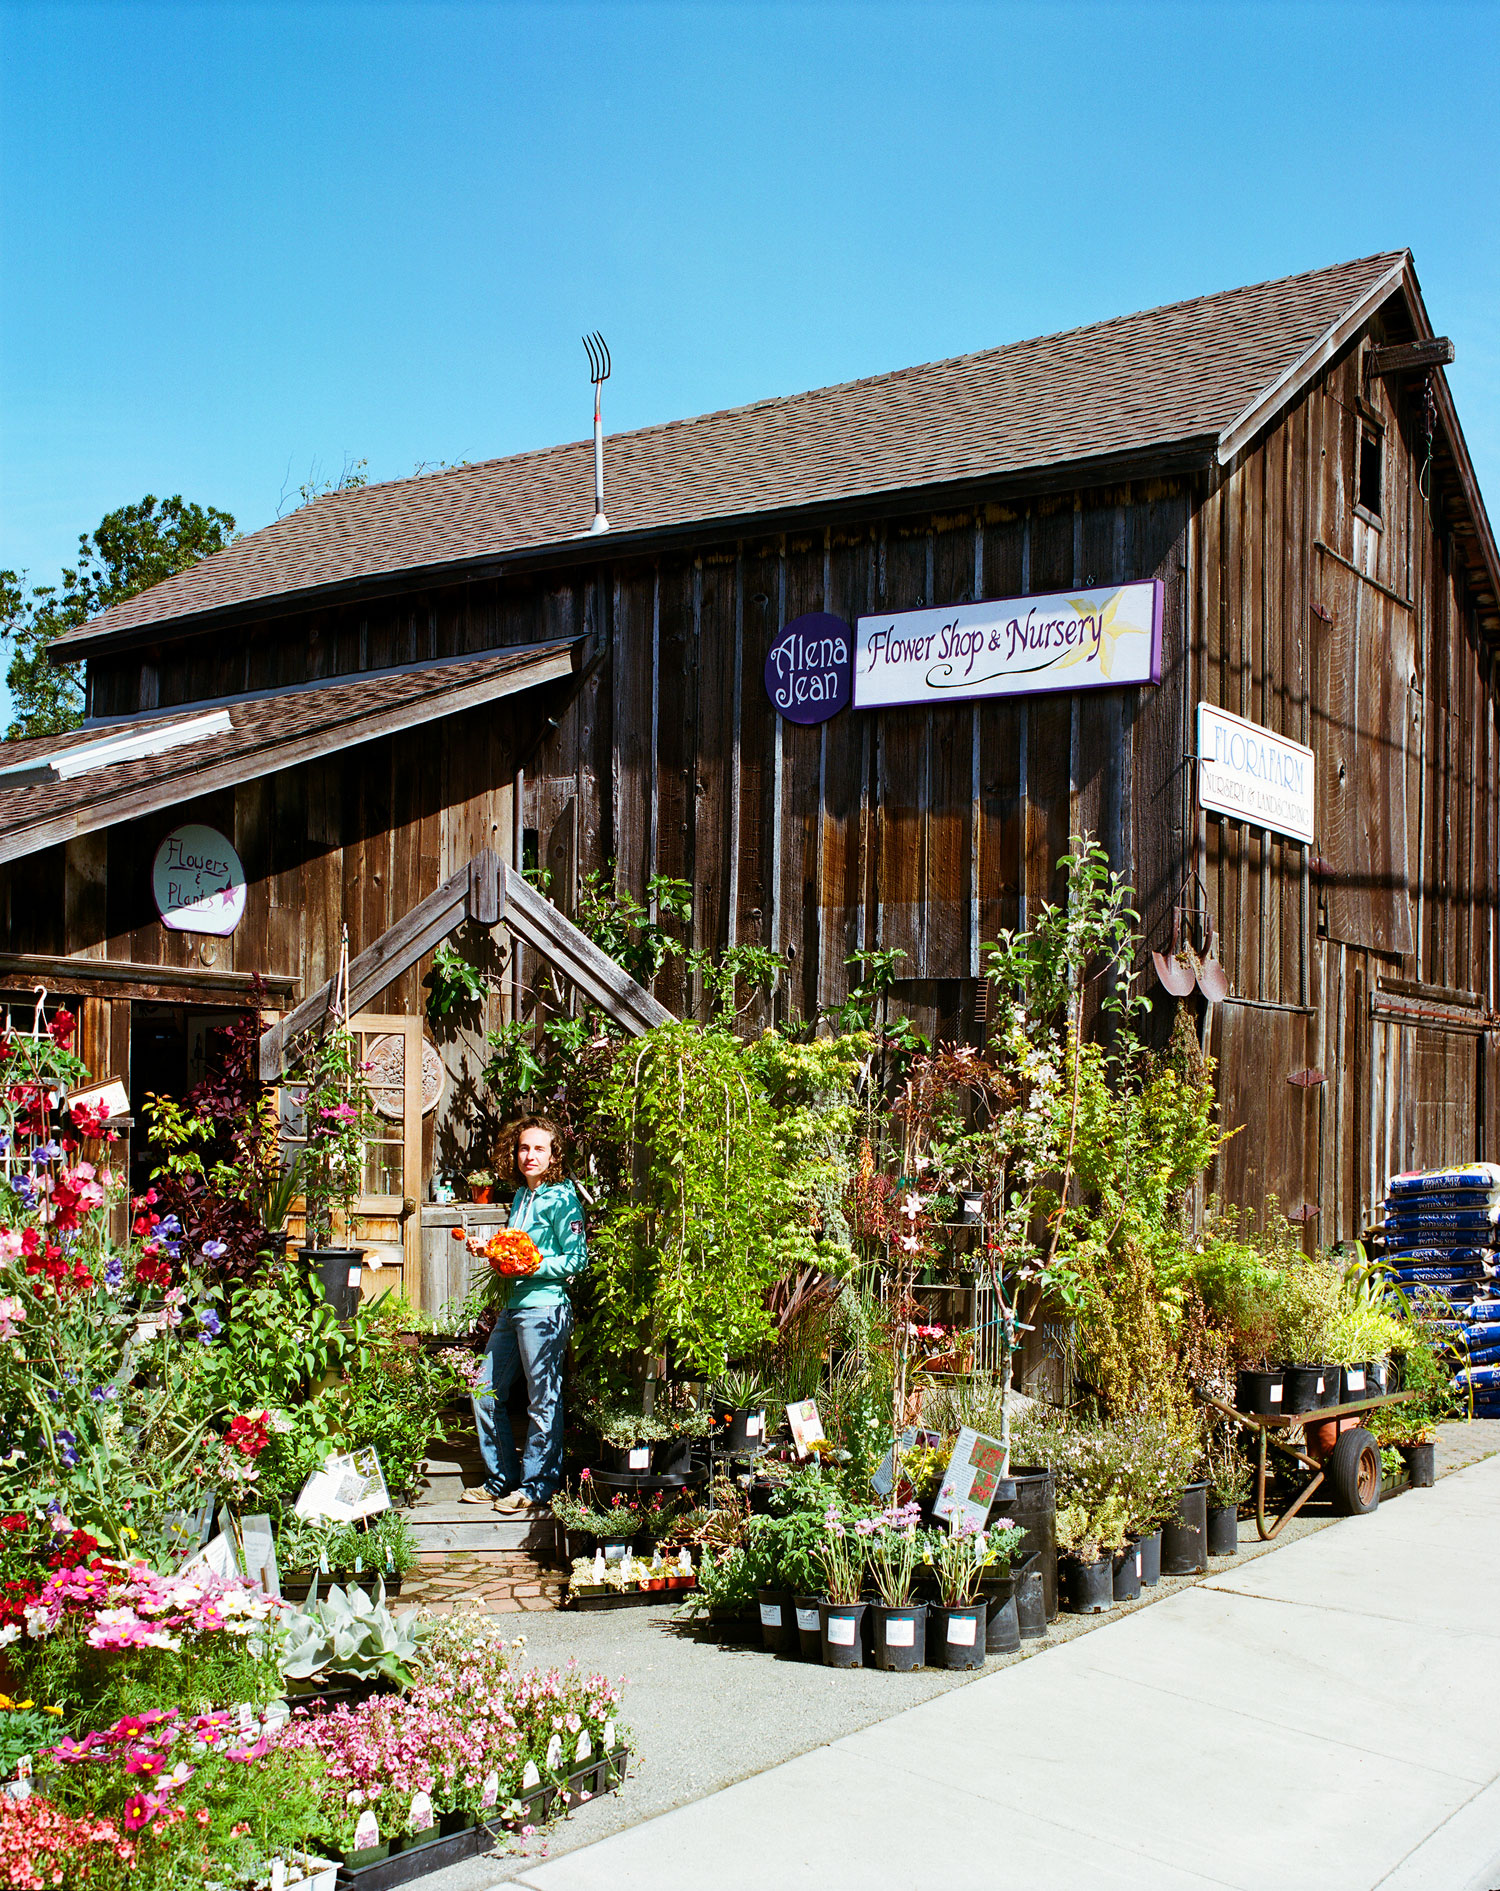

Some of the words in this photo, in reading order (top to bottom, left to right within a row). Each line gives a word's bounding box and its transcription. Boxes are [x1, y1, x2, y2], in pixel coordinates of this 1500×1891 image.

[770, 633, 848, 675] Alena
[867, 624, 936, 673] Flower
[938, 618, 984, 677] Shop
[988, 631, 1001, 650] &
[1006, 607, 1103, 663] Nursery
[776, 669, 839, 708] Jean
[165, 838, 229, 873] Flowers
[168, 882, 214, 908] Plants
